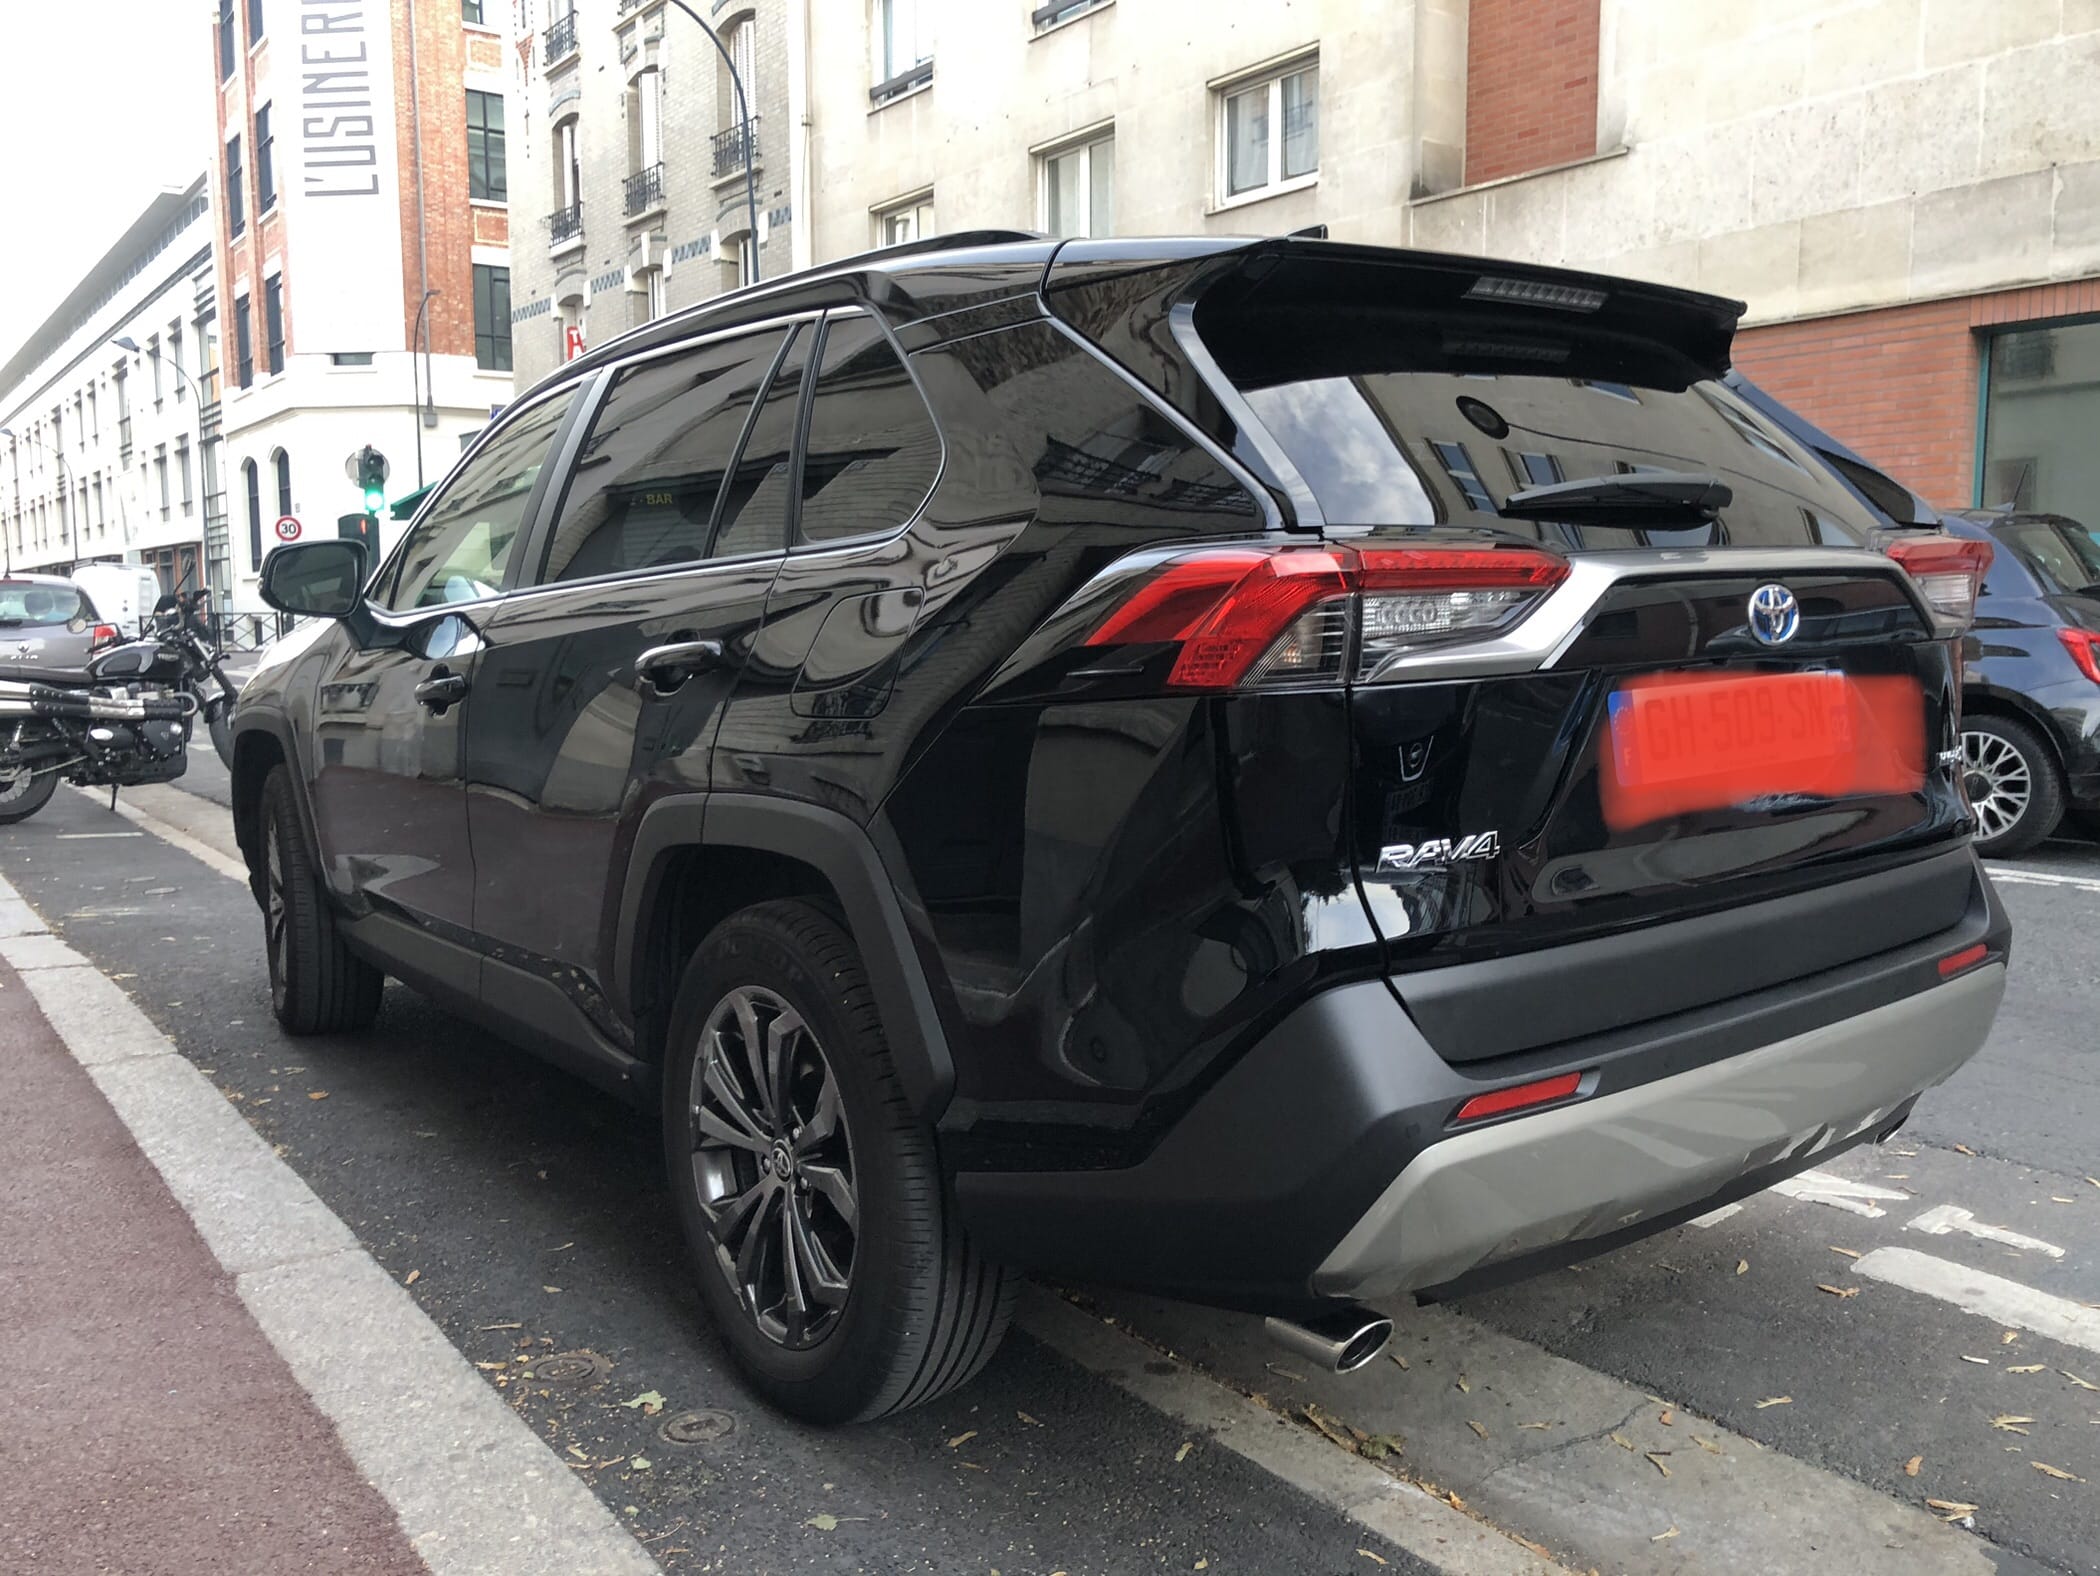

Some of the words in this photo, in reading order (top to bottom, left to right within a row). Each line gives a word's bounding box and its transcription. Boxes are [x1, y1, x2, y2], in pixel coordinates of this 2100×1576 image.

[301, 0, 379, 197] L'USINER
[646, 493, 673, 505] BAR
[281, 523, 297, 534] 30
[1375, 830, 1501, 873] RAV4
